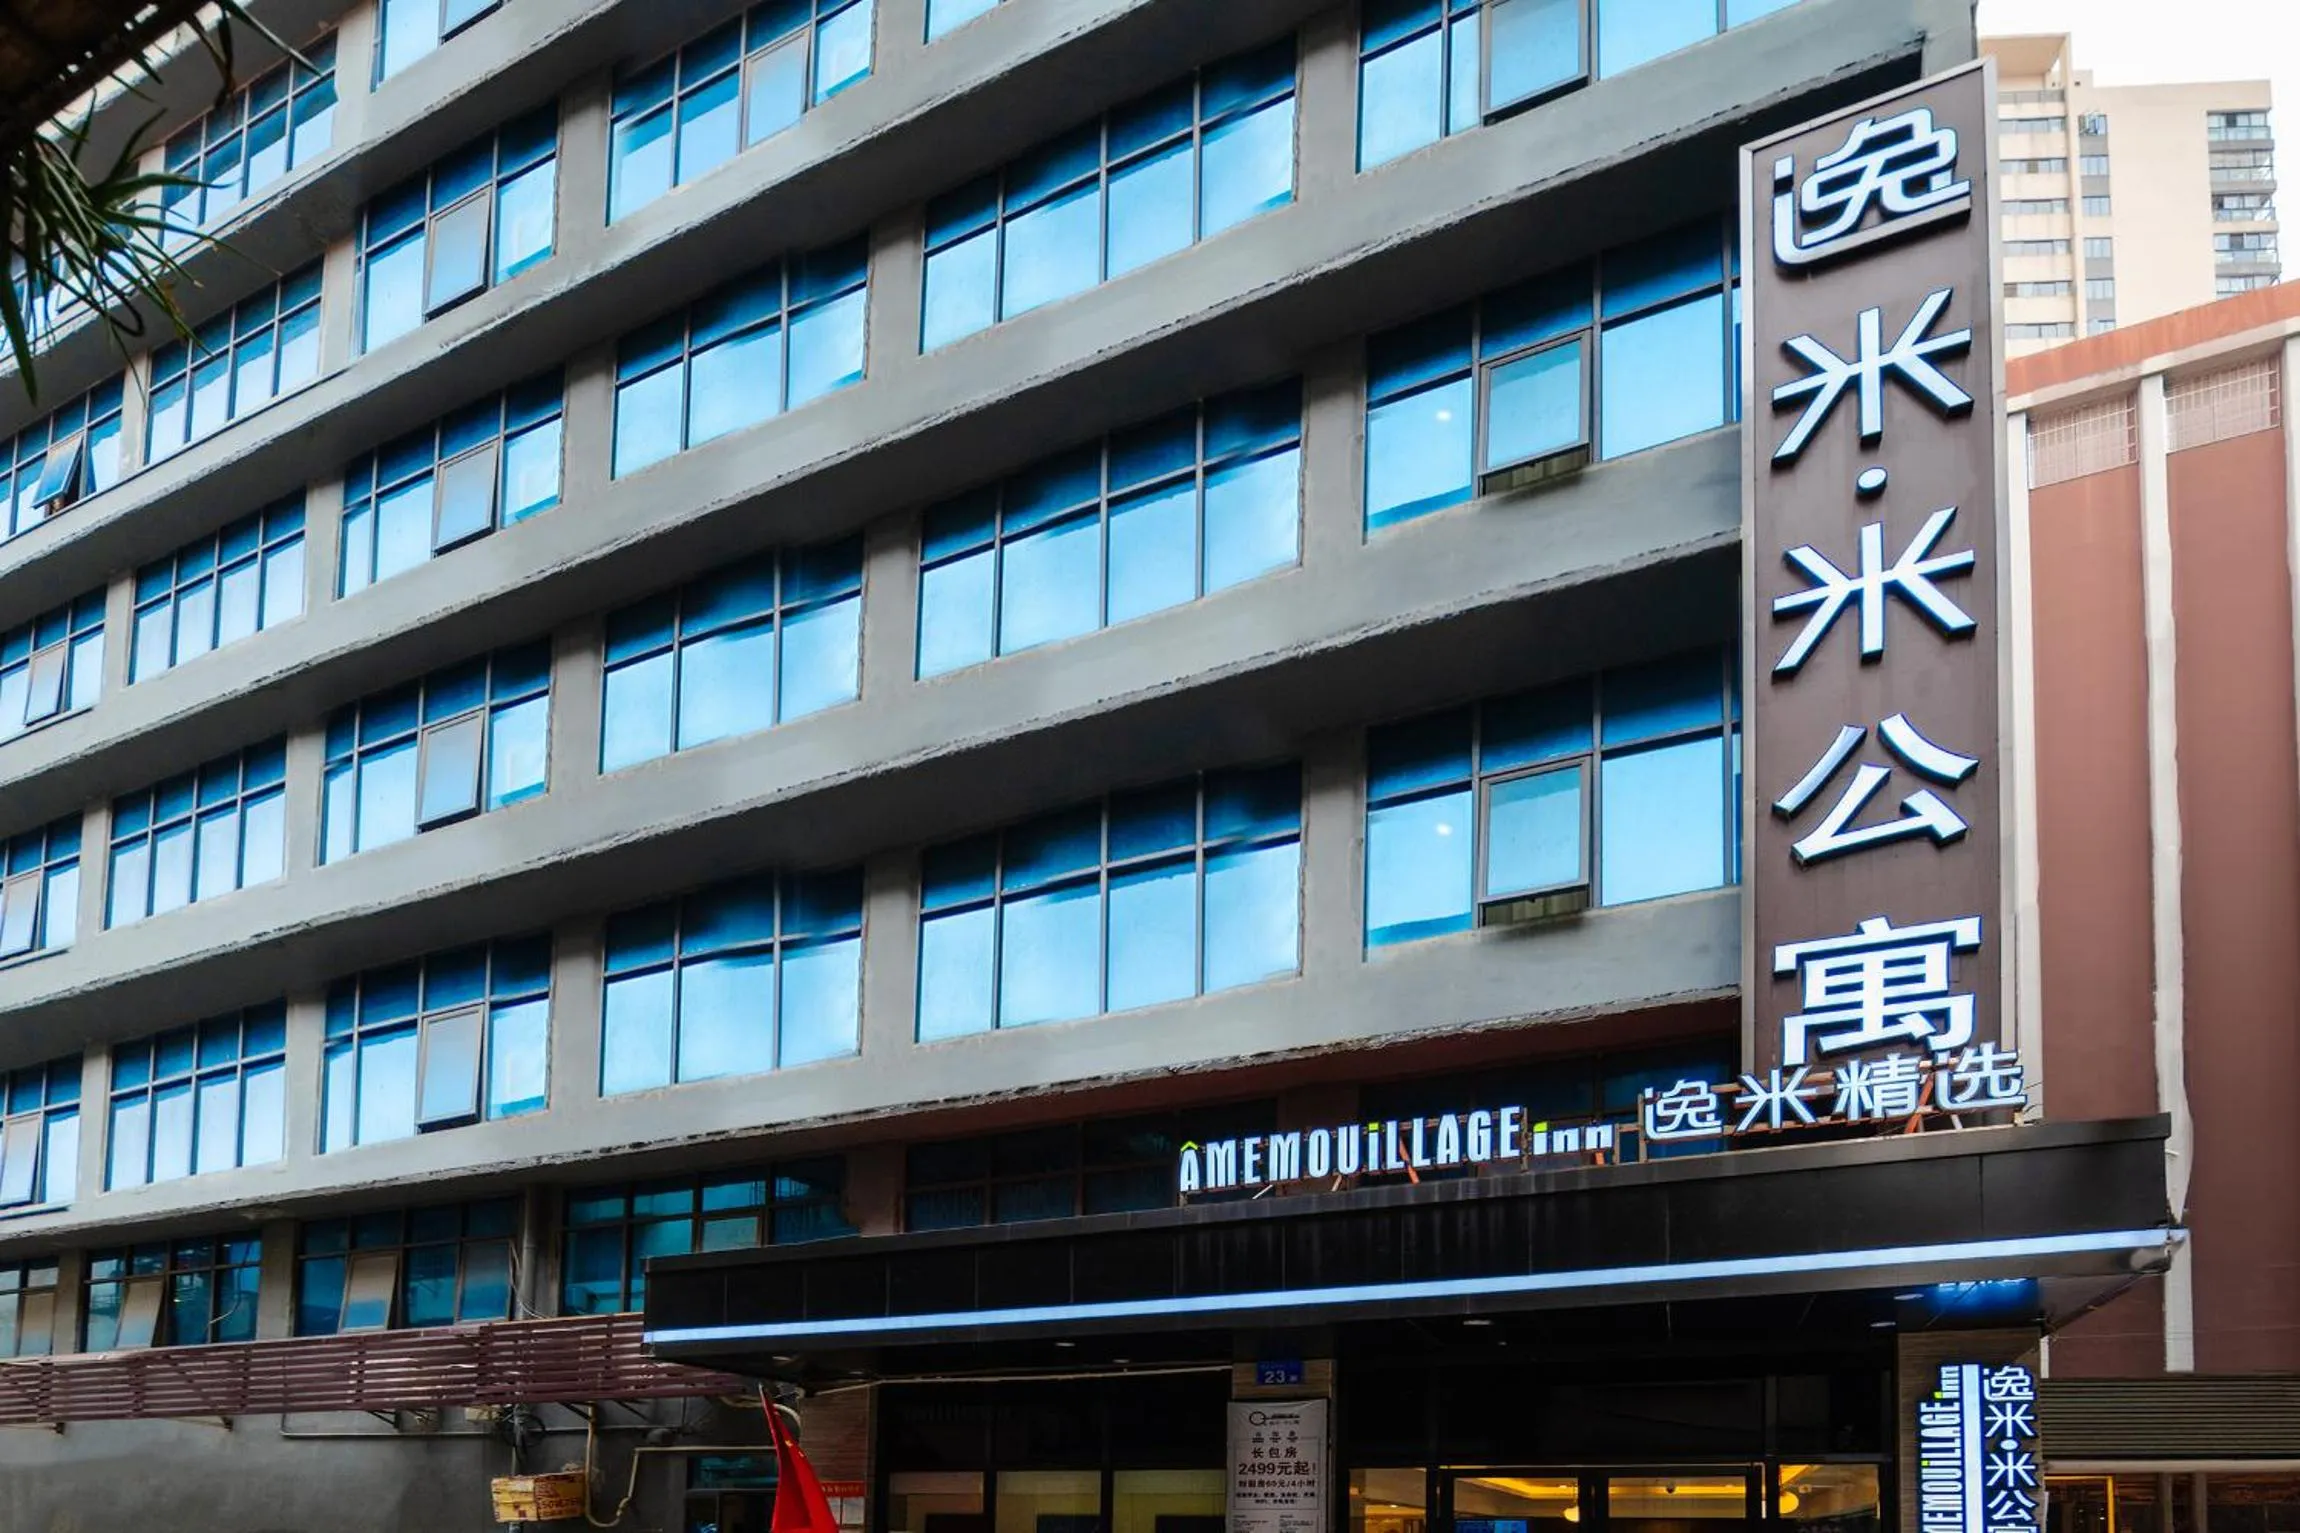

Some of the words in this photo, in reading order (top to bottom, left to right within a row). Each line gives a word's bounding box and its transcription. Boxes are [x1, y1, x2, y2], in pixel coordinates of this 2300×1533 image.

[1644, 1041, 2028, 1141] 逸米精选
[1533, 1121, 1614, 1156] inn
[1251, 1446, 1299, 1459] 长包房
[1983, 1365, 2037, 1533] 逸米·米公
